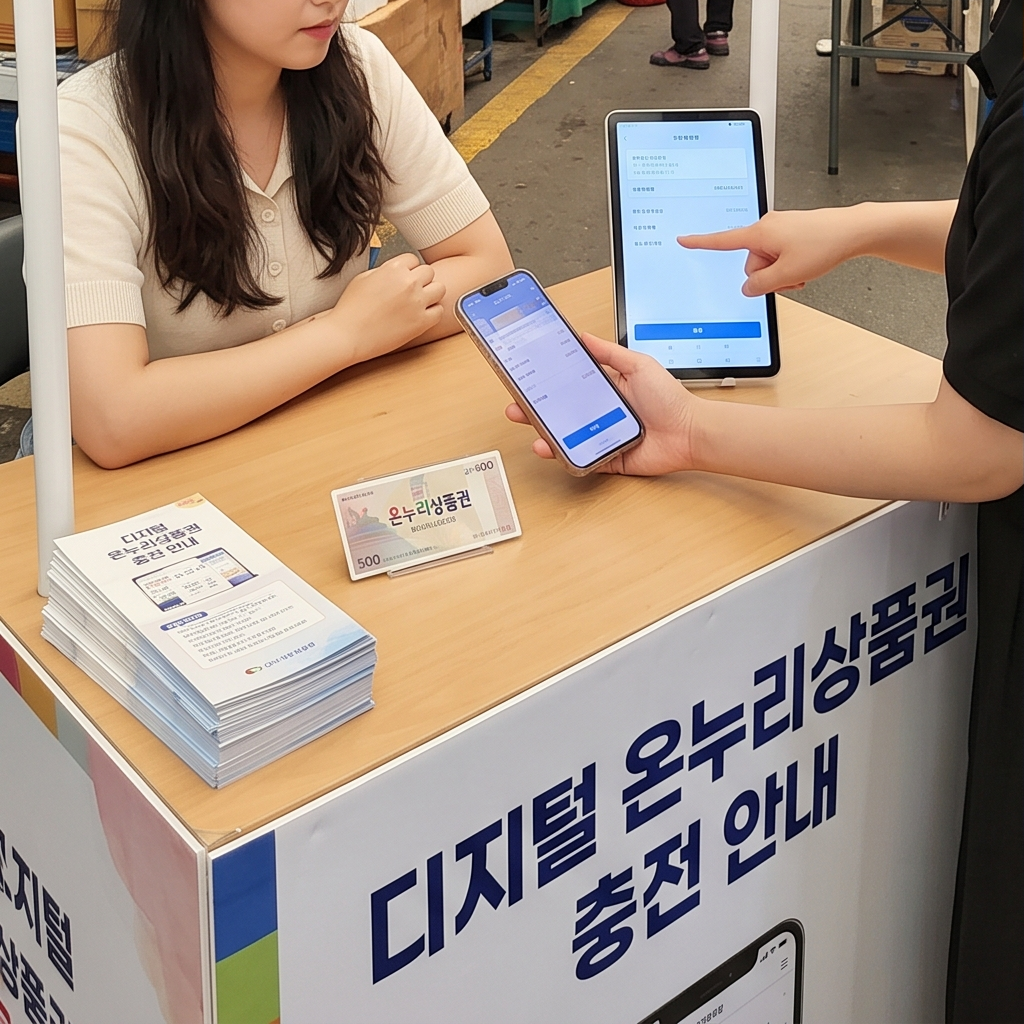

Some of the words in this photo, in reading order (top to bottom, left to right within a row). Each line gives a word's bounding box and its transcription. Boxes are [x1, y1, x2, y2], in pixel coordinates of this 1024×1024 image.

[357, 554, 381, 570] 500
[370, 761, 597, 986] 디지털
[621, 552, 970, 835] 온누리상품권
[571, 818, 701, 981] 충전
[722, 733, 839, 886] 안내
